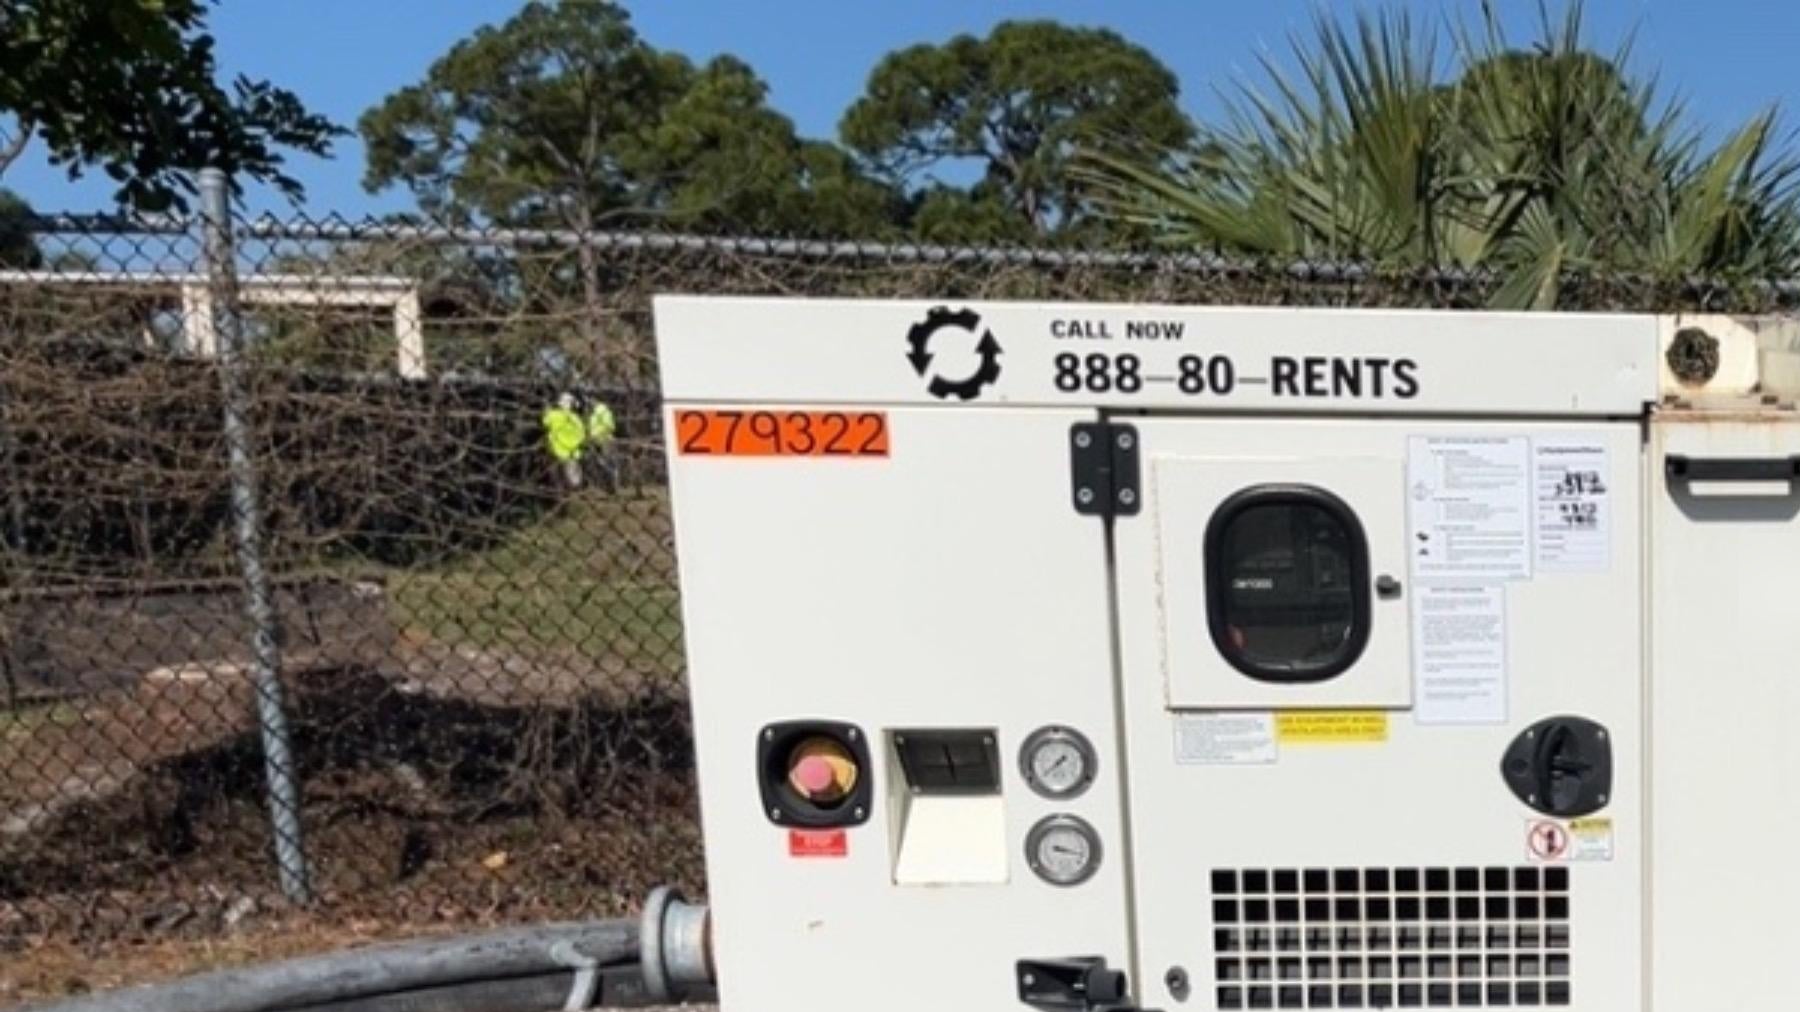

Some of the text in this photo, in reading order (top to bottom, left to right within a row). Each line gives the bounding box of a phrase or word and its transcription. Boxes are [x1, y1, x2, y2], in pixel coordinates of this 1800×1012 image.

[1050, 319, 1185, 340] CALL NOW
[680, 411, 889, 455] 279322
